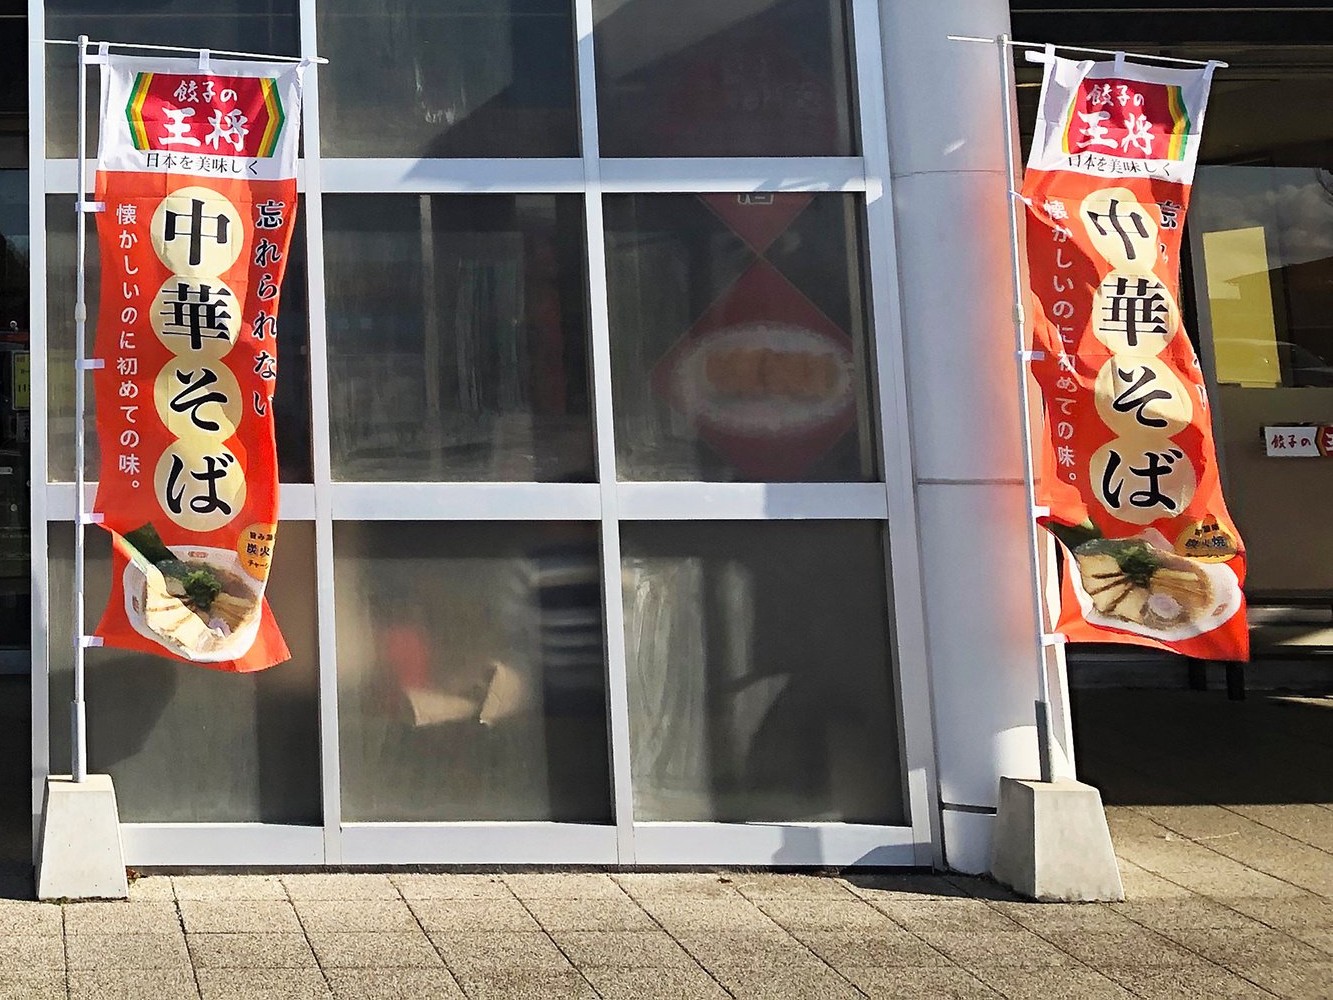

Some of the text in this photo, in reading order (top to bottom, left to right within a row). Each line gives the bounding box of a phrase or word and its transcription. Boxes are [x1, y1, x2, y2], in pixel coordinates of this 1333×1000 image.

[173, 79, 238, 104] 餃子の
[1085, 83, 1145, 107] 餃子の
[158, 107, 250, 152] 王将
[1076, 111, 1155, 155] 王将
[146, 152, 259, 175] 日本を美味しく
[1068, 154, 1171, 177] 日本を美味しく
[116, 202, 141, 489] 懐かしいのに初めての味。
[159, 198, 233, 516] 中華そば
[1087, 198, 1183, 511] 中華そば
[1271, 434, 1311, 449] 餃子の
